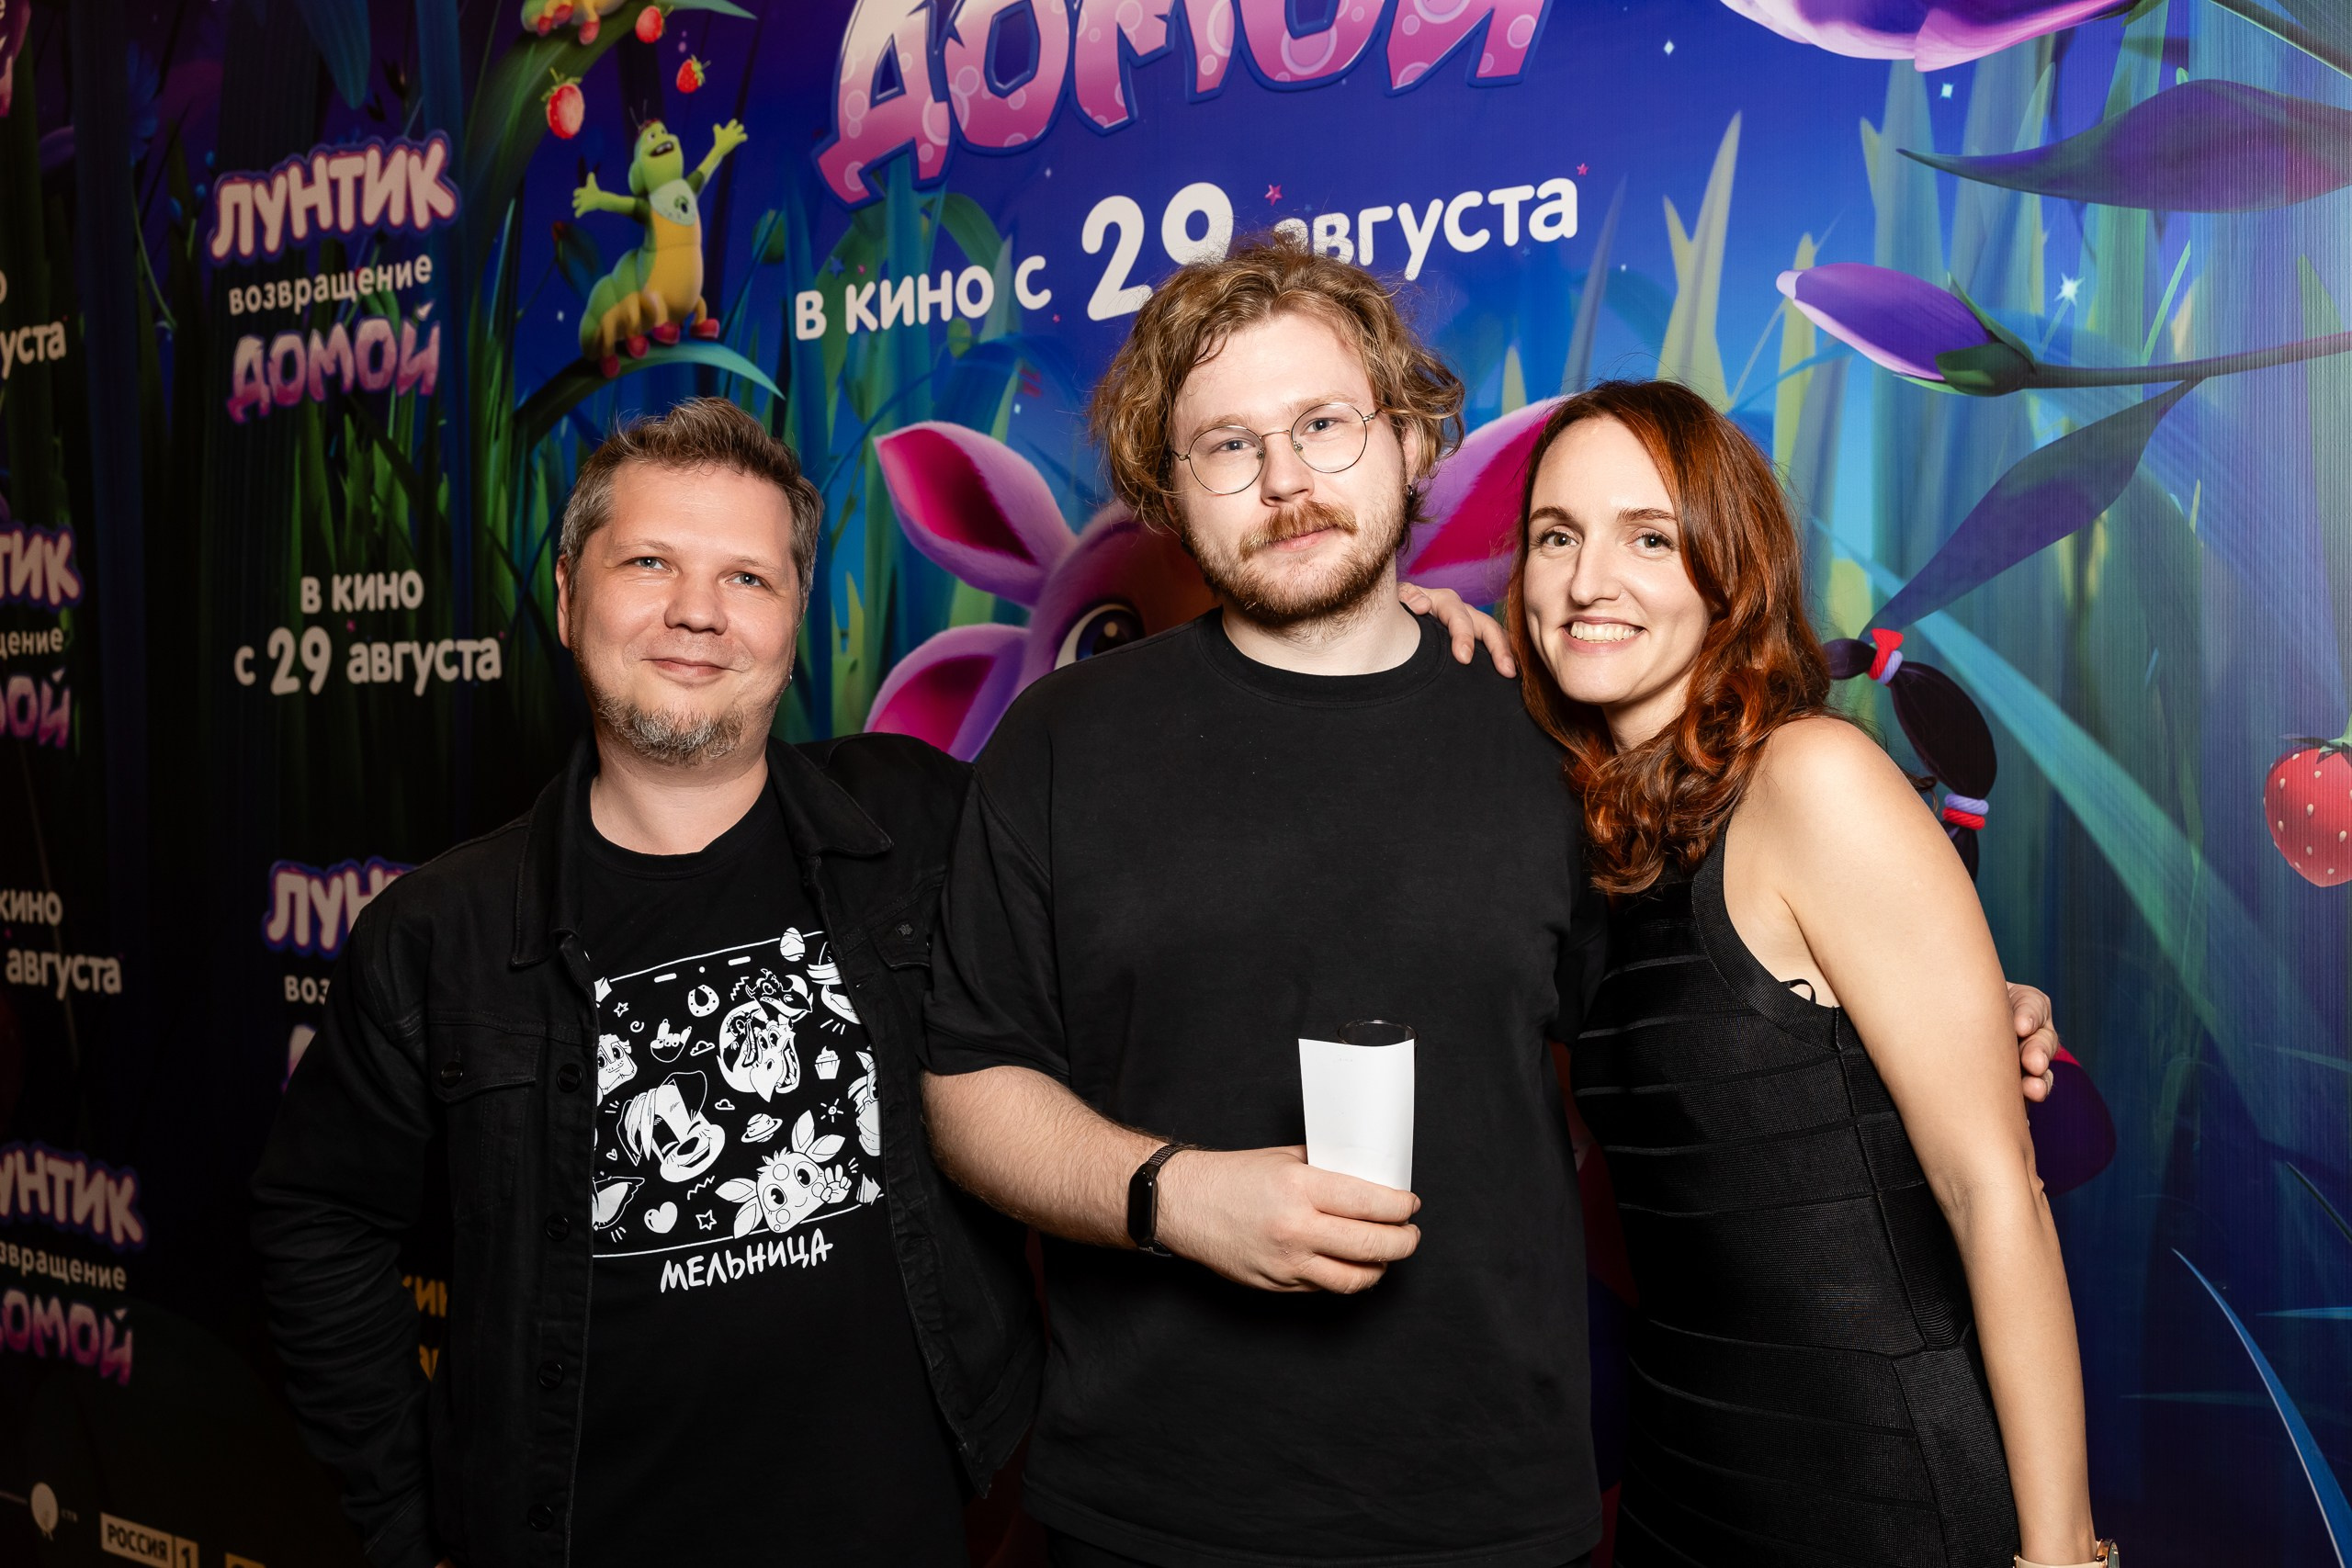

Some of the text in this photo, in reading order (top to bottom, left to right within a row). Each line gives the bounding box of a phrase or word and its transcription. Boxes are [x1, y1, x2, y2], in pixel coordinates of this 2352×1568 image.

[210, 138, 457, 259] ЛУНТИК
[228, 254, 434, 316] возвращение
[794, 289, 828, 341] в
[845, 264, 995, 335] кино
[1014, 254, 1052, 310] с
[0, 319, 67, 381] уста
[226, 299, 440, 423] ДОМОЙ
[300, 569, 424, 615] в кино
[234, 626, 502, 697] с 29 августа
[5, 946, 123, 1002] августа
[660, 1227, 833, 1294] МЕЛЬНИЦА
[0, 1286, 136, 1388] ОМОЙ
[107, 1522, 167, 1562] РОССИЯ
